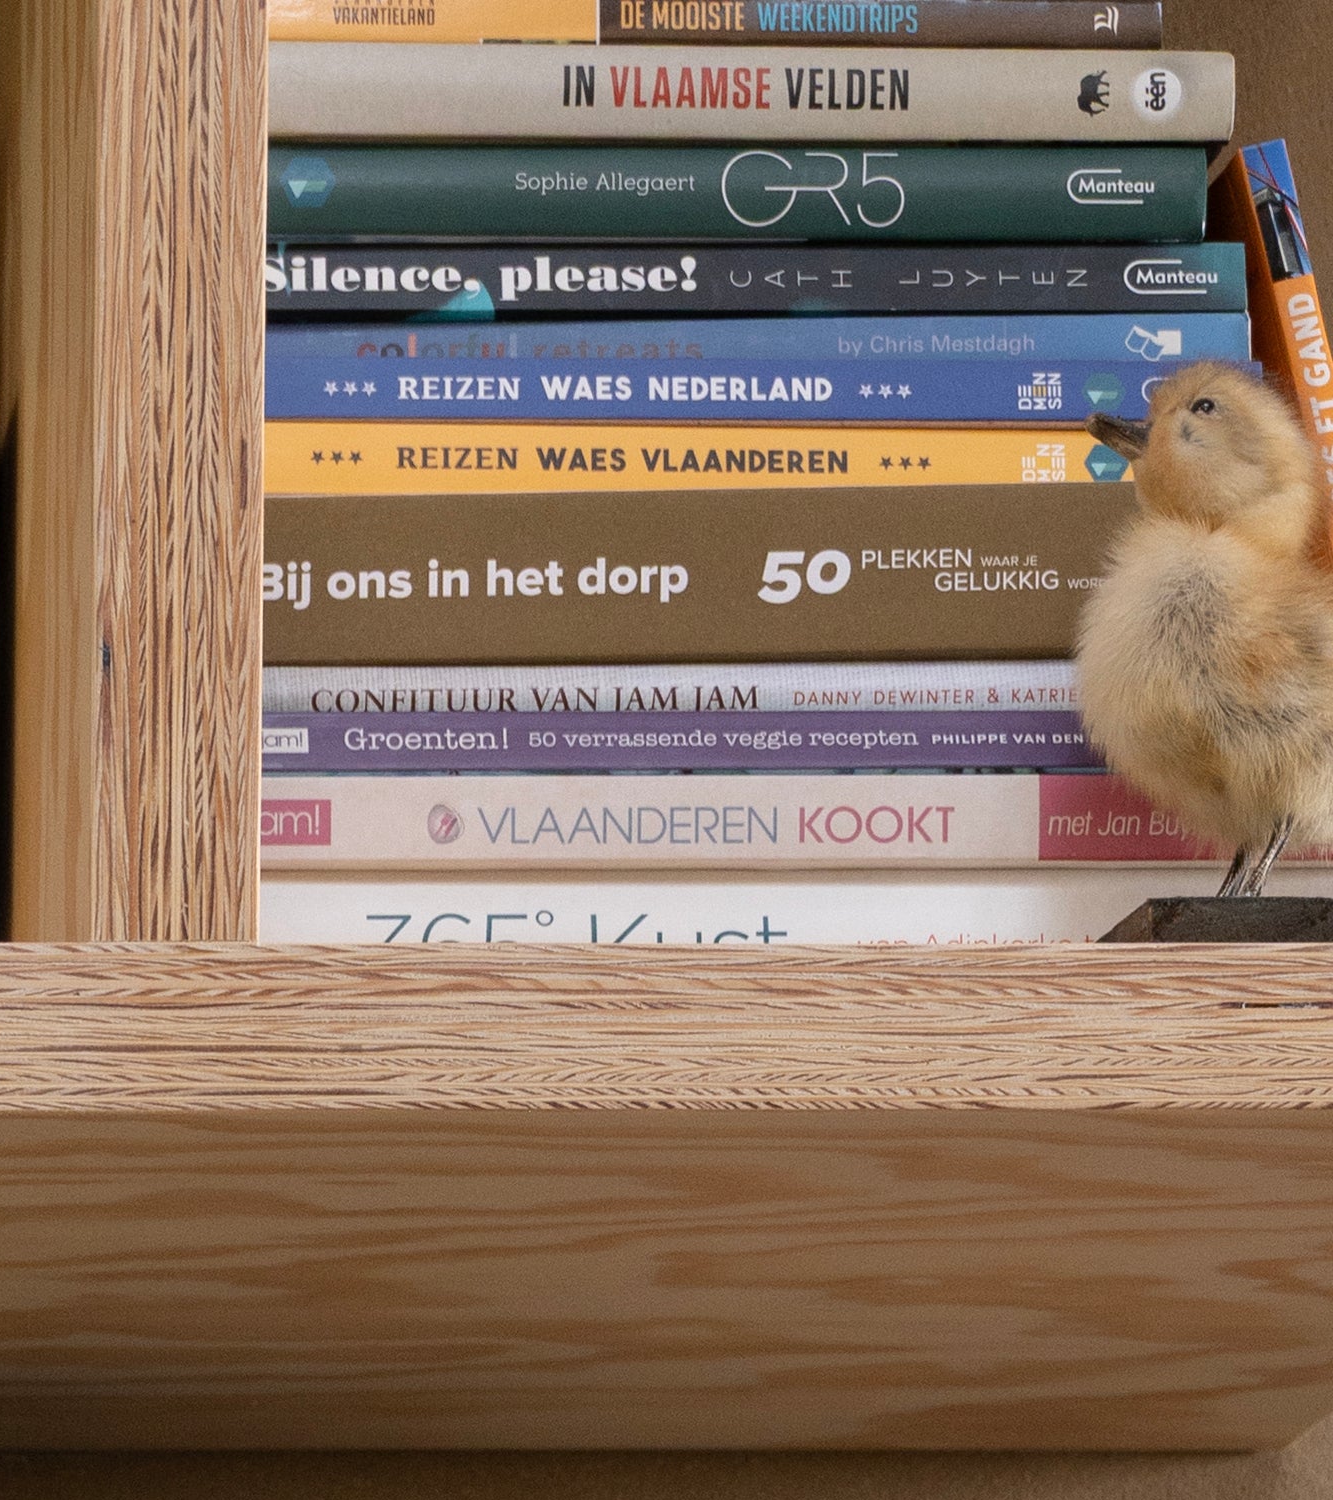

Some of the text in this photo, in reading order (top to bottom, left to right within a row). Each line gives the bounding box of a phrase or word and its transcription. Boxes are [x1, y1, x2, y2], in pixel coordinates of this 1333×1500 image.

[563, 65, 911, 111] IN VLAAMSE VELDEN
[515, 150, 906, 228] Sophie Allegaert GR5
[1078, 178, 1156, 195] Manteau
[398, 376, 833, 401] REIZEN WAES NEDERLAND
[262, 558, 689, 610] Bij ons in het dorp
[757, 549, 1038, 604] 50 PLEKKEN WAAR JE
[934, 571, 1059, 593] GELUKKIG
[344, 728, 1084, 751] Groenten! 50 verrassende veggie recepten PHILIPPE VAN DEN
[477, 806, 955, 845] VLAANDEREN KOOKT
